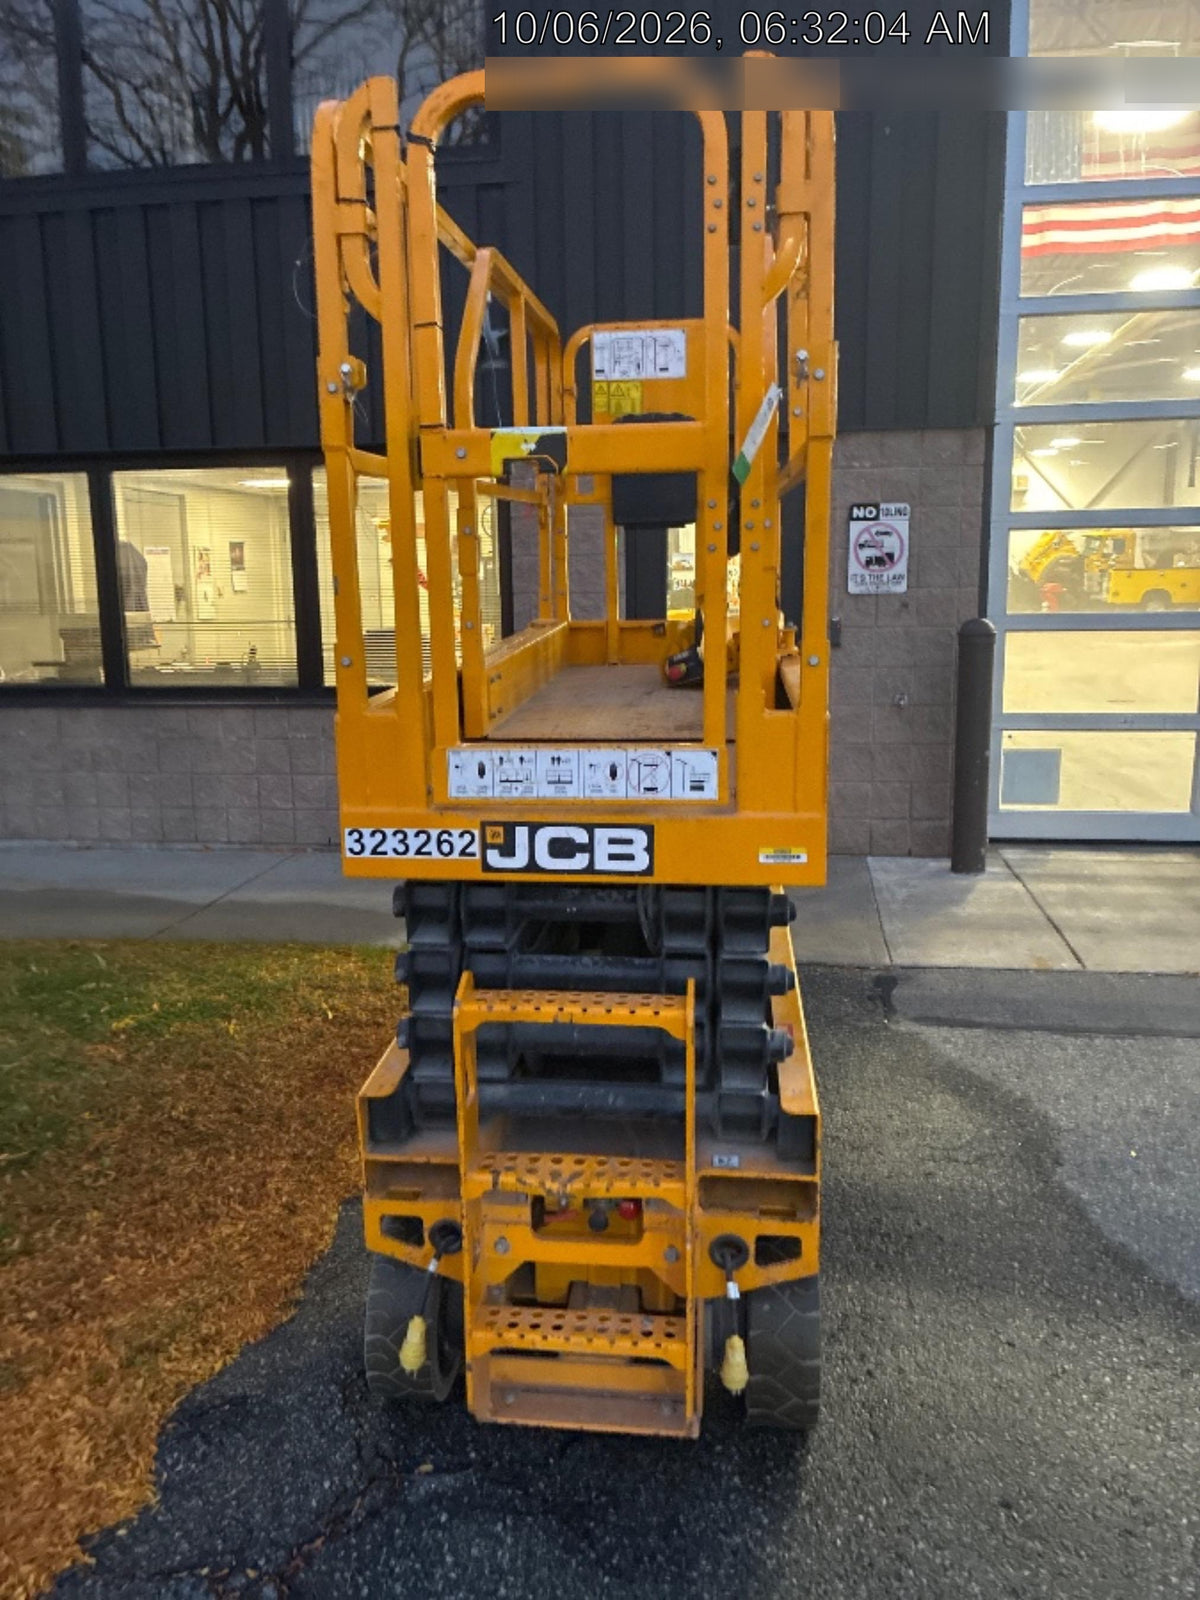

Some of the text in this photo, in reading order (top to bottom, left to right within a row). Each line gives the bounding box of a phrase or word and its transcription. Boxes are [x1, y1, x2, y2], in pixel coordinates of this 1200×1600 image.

[852, 506, 877, 518] NO
[347, 829, 477, 857] 323262
[486, 826, 650, 872] JCB
